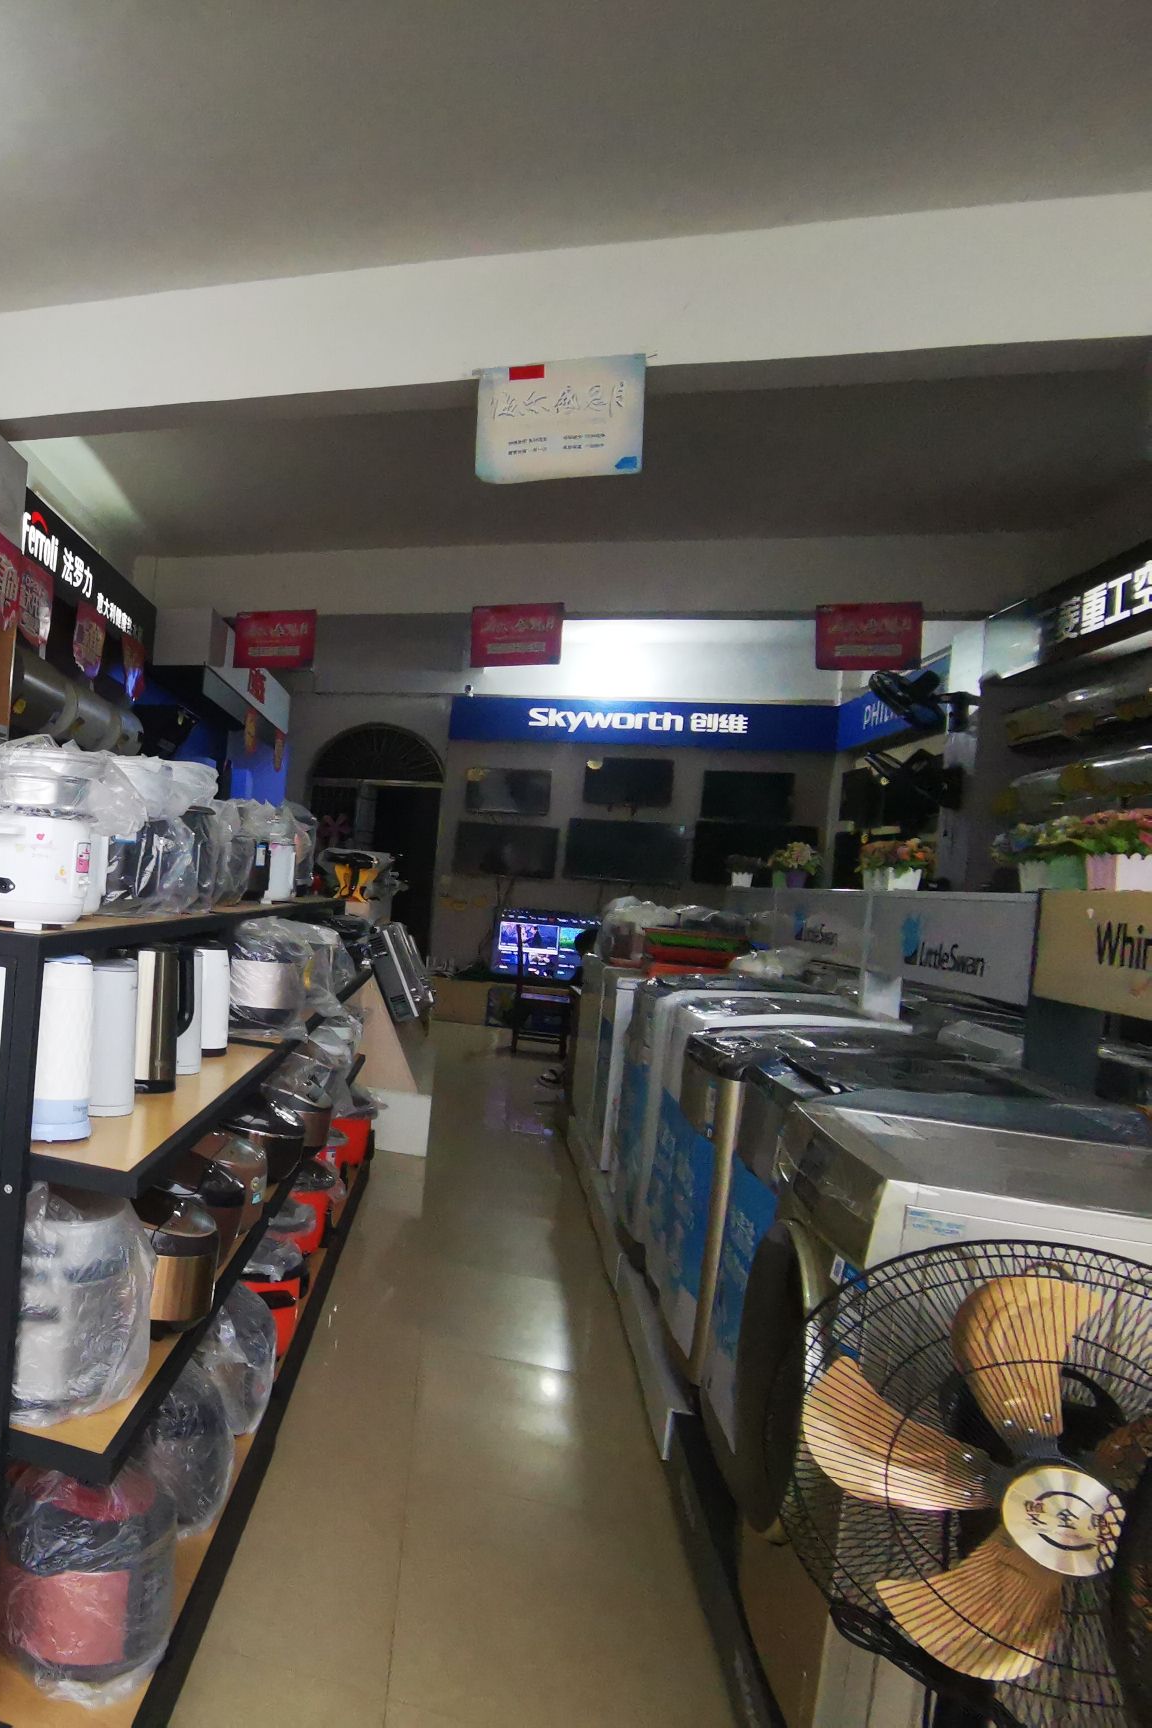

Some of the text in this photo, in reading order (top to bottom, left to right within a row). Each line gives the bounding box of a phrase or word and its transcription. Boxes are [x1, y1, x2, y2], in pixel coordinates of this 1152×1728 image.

[22, 511, 59, 573] Ferroli
[62, 547, 93, 598] 法罗力
[528, 707, 749, 734] Skyworth 创维
